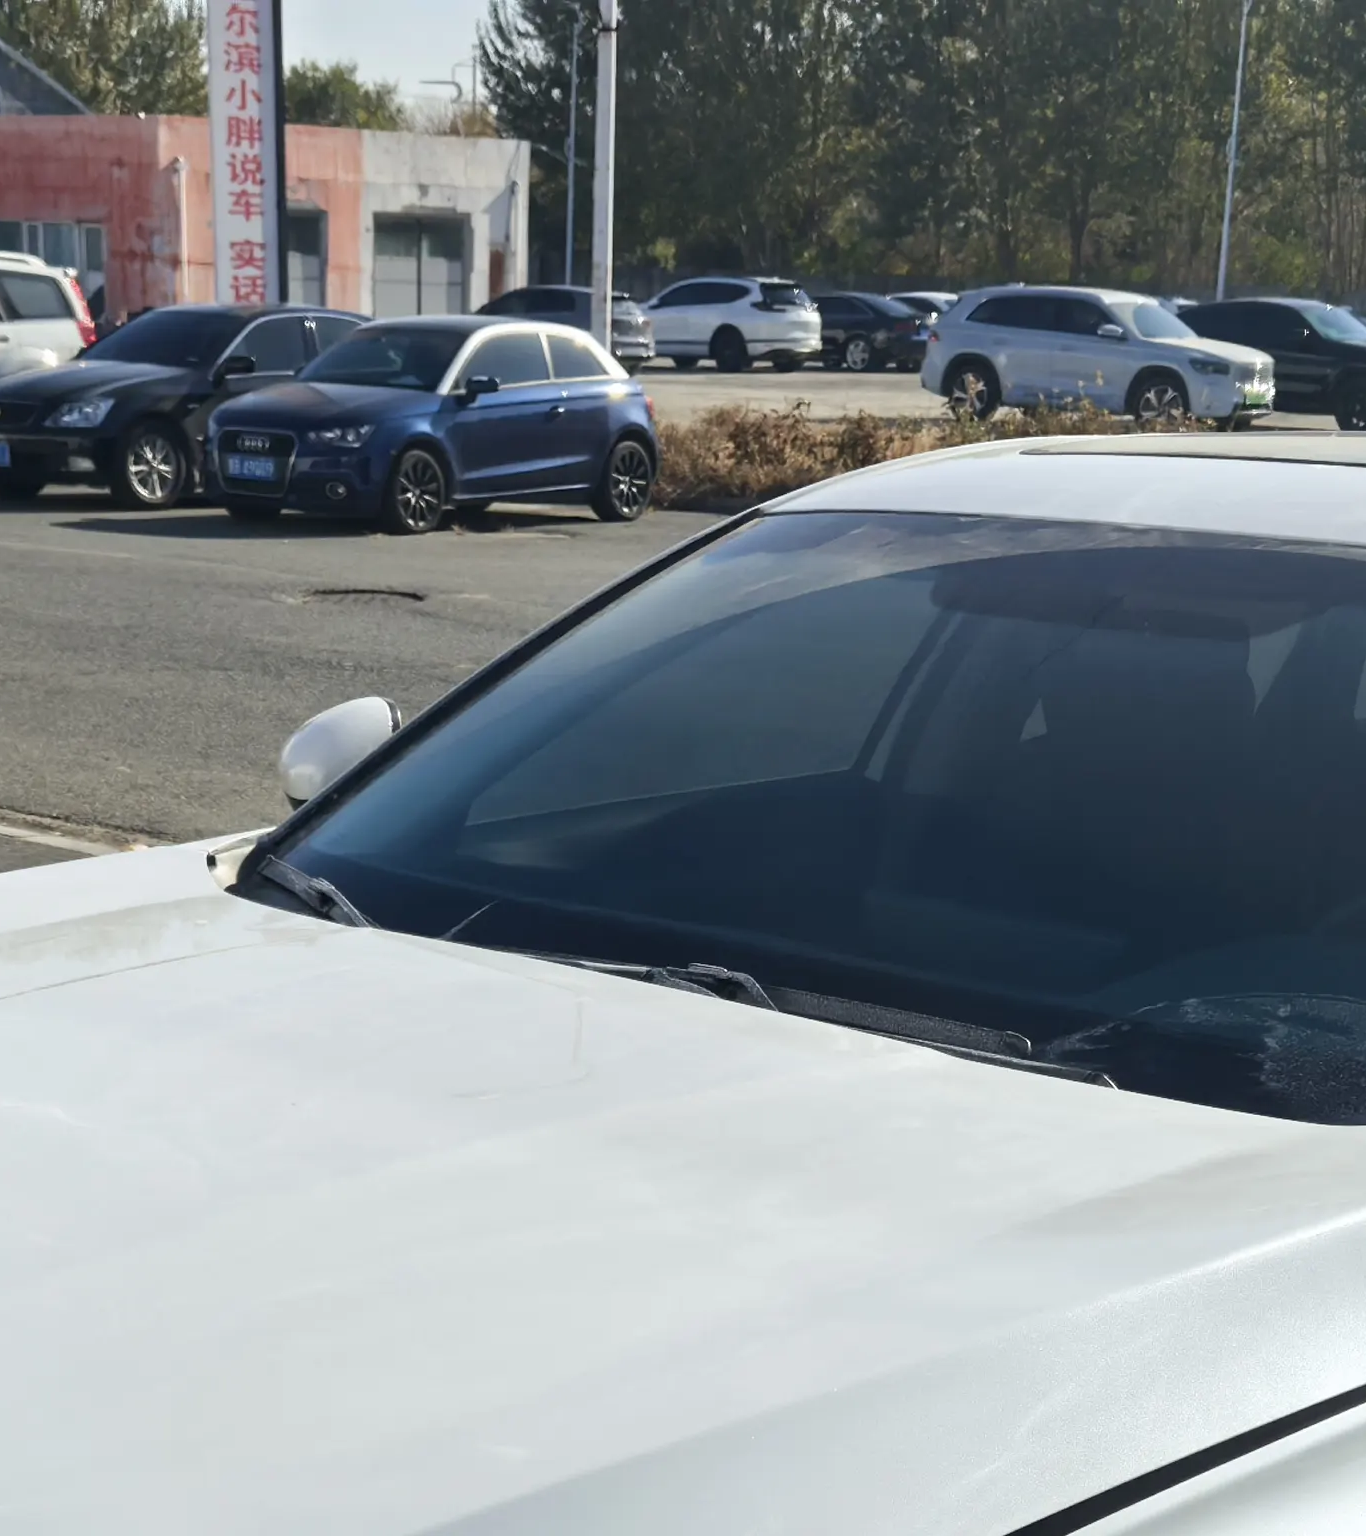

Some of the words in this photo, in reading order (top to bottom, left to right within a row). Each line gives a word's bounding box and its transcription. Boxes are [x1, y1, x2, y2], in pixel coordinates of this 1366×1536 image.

[223, 4, 265, 222] 尔滨小胖说车
[229, 240, 266, 304] 实话
